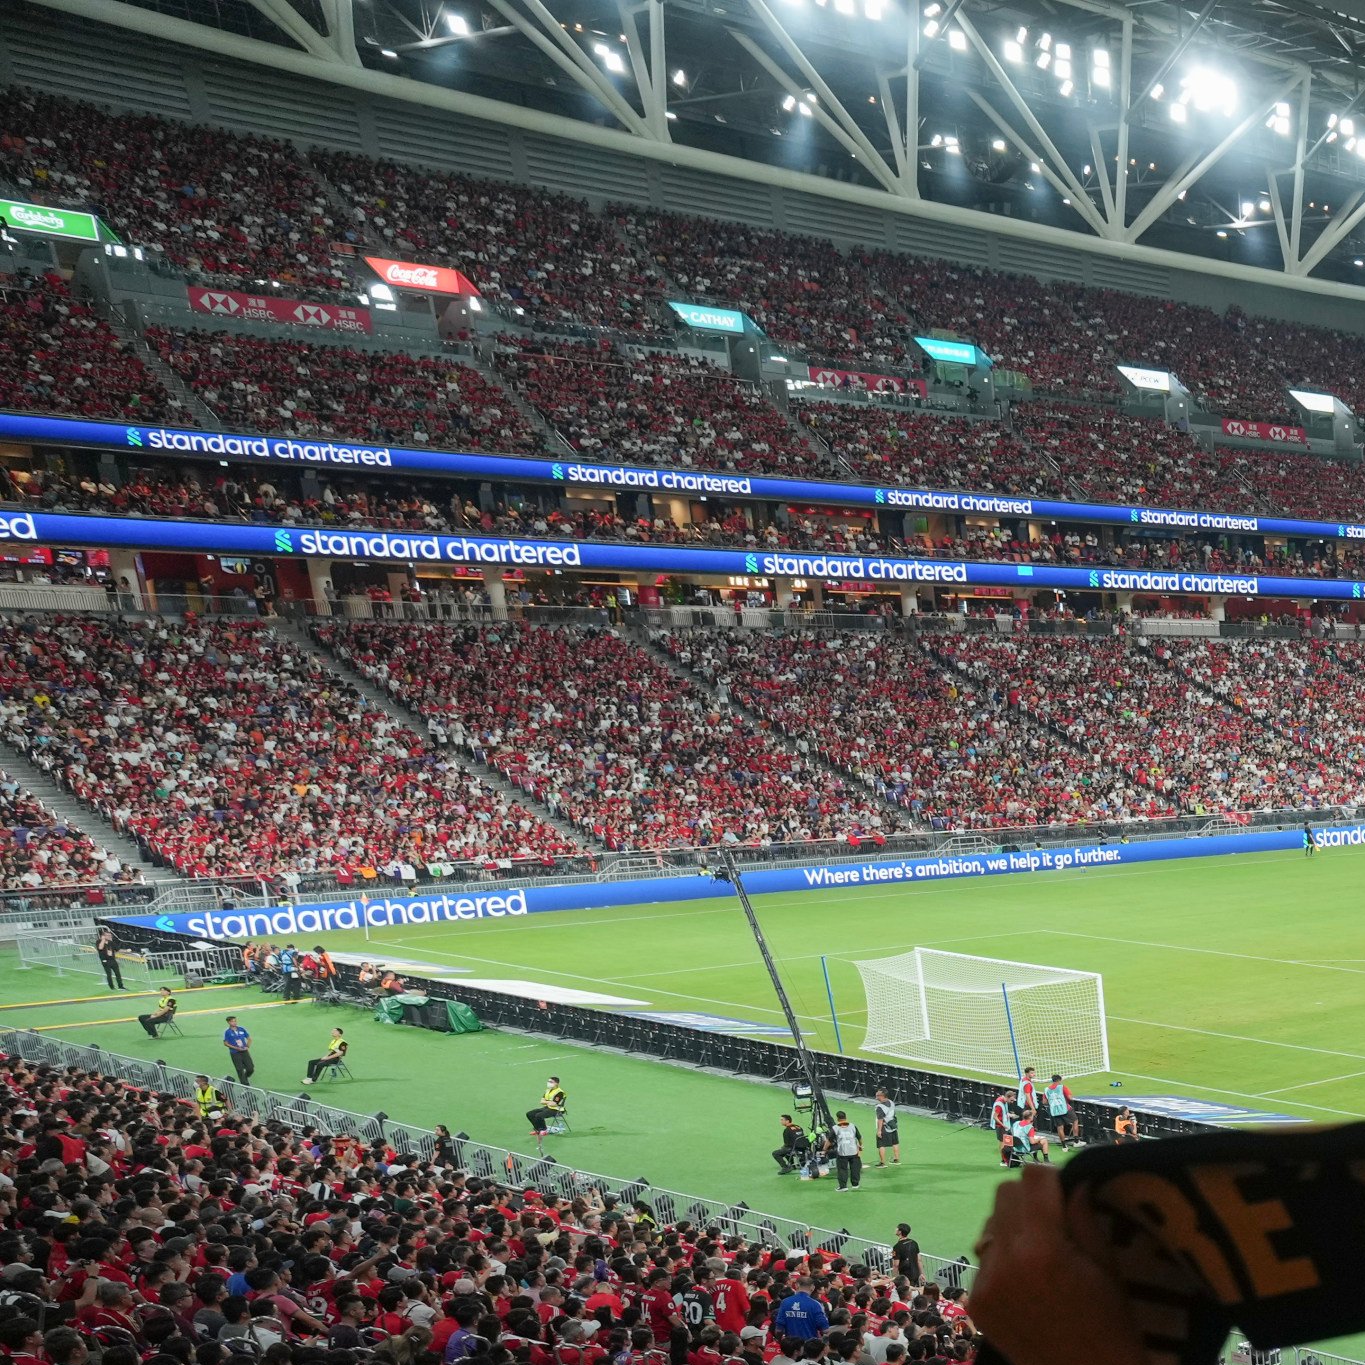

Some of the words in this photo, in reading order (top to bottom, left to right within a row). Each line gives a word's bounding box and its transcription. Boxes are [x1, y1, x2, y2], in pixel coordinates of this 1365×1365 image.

[10, 206, 64, 229] Carlsberg
[243, 307, 275, 319] HSBC
[334, 319, 364, 331] HSBC
[691, 312, 735, 328] CATHAY
[149, 429, 268, 457] standard
[274, 440, 391, 467] chartered
[568, 464, 658, 487] standard
[662, 472, 751, 494] chartered
[887, 489, 958, 509] standard
[961, 495, 1032, 515] chartered
[1140, 509, 1198, 526] standard
[1200, 514, 1258, 531] chartered
[301, 530, 441, 562] standard
[447, 539, 581, 566] chartered
[764, 554, 864, 579] standard
[869, 559, 966, 583] chartered
[1103, 570, 1179, 591] standard
[1182, 574, 1258, 594] chartered
[804, 866, 860, 885] Where
[862, 862, 913, 881] there's
[915, 856, 985, 878] ambition,
[987, 858, 1008, 871] we
[1010, 853, 1039, 872] help
[1042, 852, 1053, 866] it
[1055, 855, 1073, 871] go
[1075, 848, 1121, 864] further.
[188, 902, 360, 940] standard
[366, 890, 529, 927] chartered
[717, 1292, 727, 1313] 4
